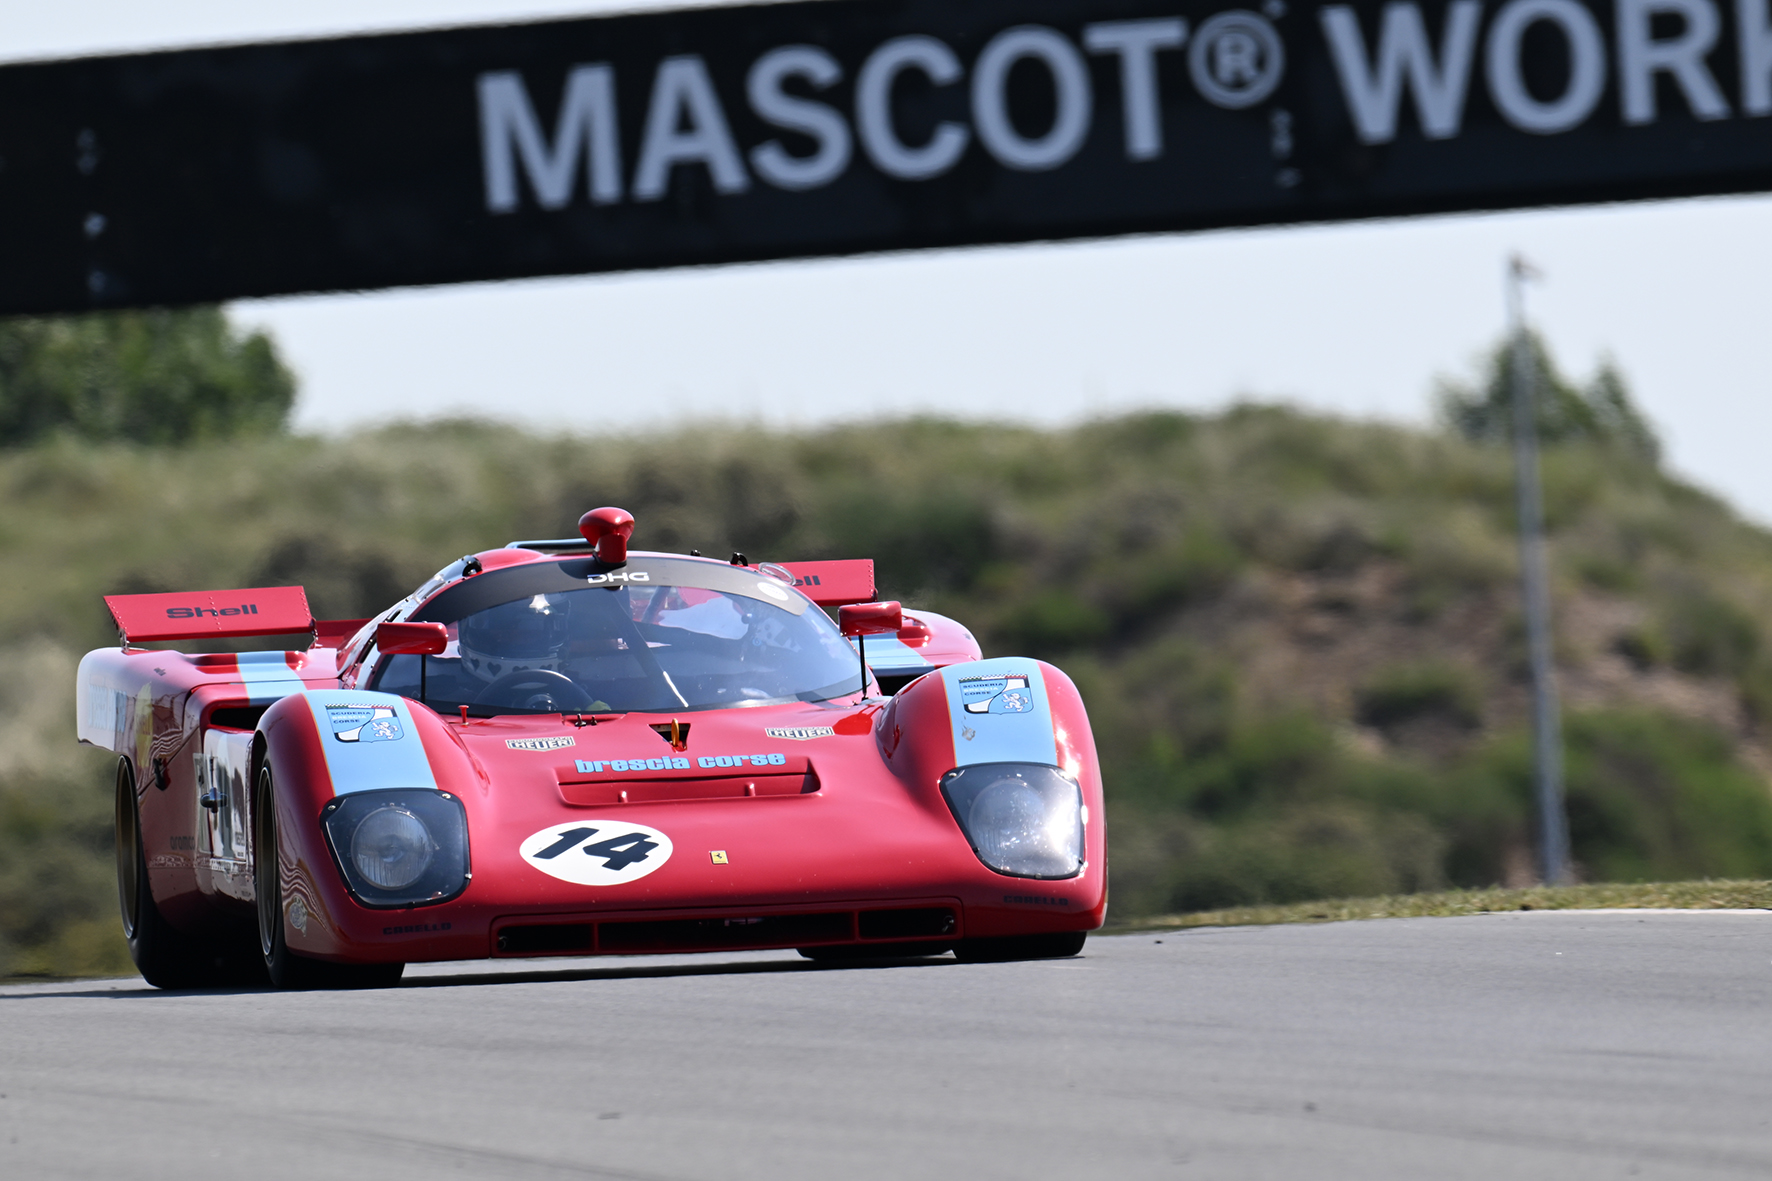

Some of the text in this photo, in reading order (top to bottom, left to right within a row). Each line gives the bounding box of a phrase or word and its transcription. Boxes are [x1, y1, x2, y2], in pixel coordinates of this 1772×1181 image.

[587, 571, 650, 584] DHG
[166, 604, 259, 619] Shell
[769, 729, 831, 738] HEUER
[508, 739, 572, 749] HEUER
[574, 753, 786, 773] brescia corse
[532, 827, 660, 871] 14
[1003, 895, 1069, 906] CARELLO
[382, 922, 452, 935] CARELLO
